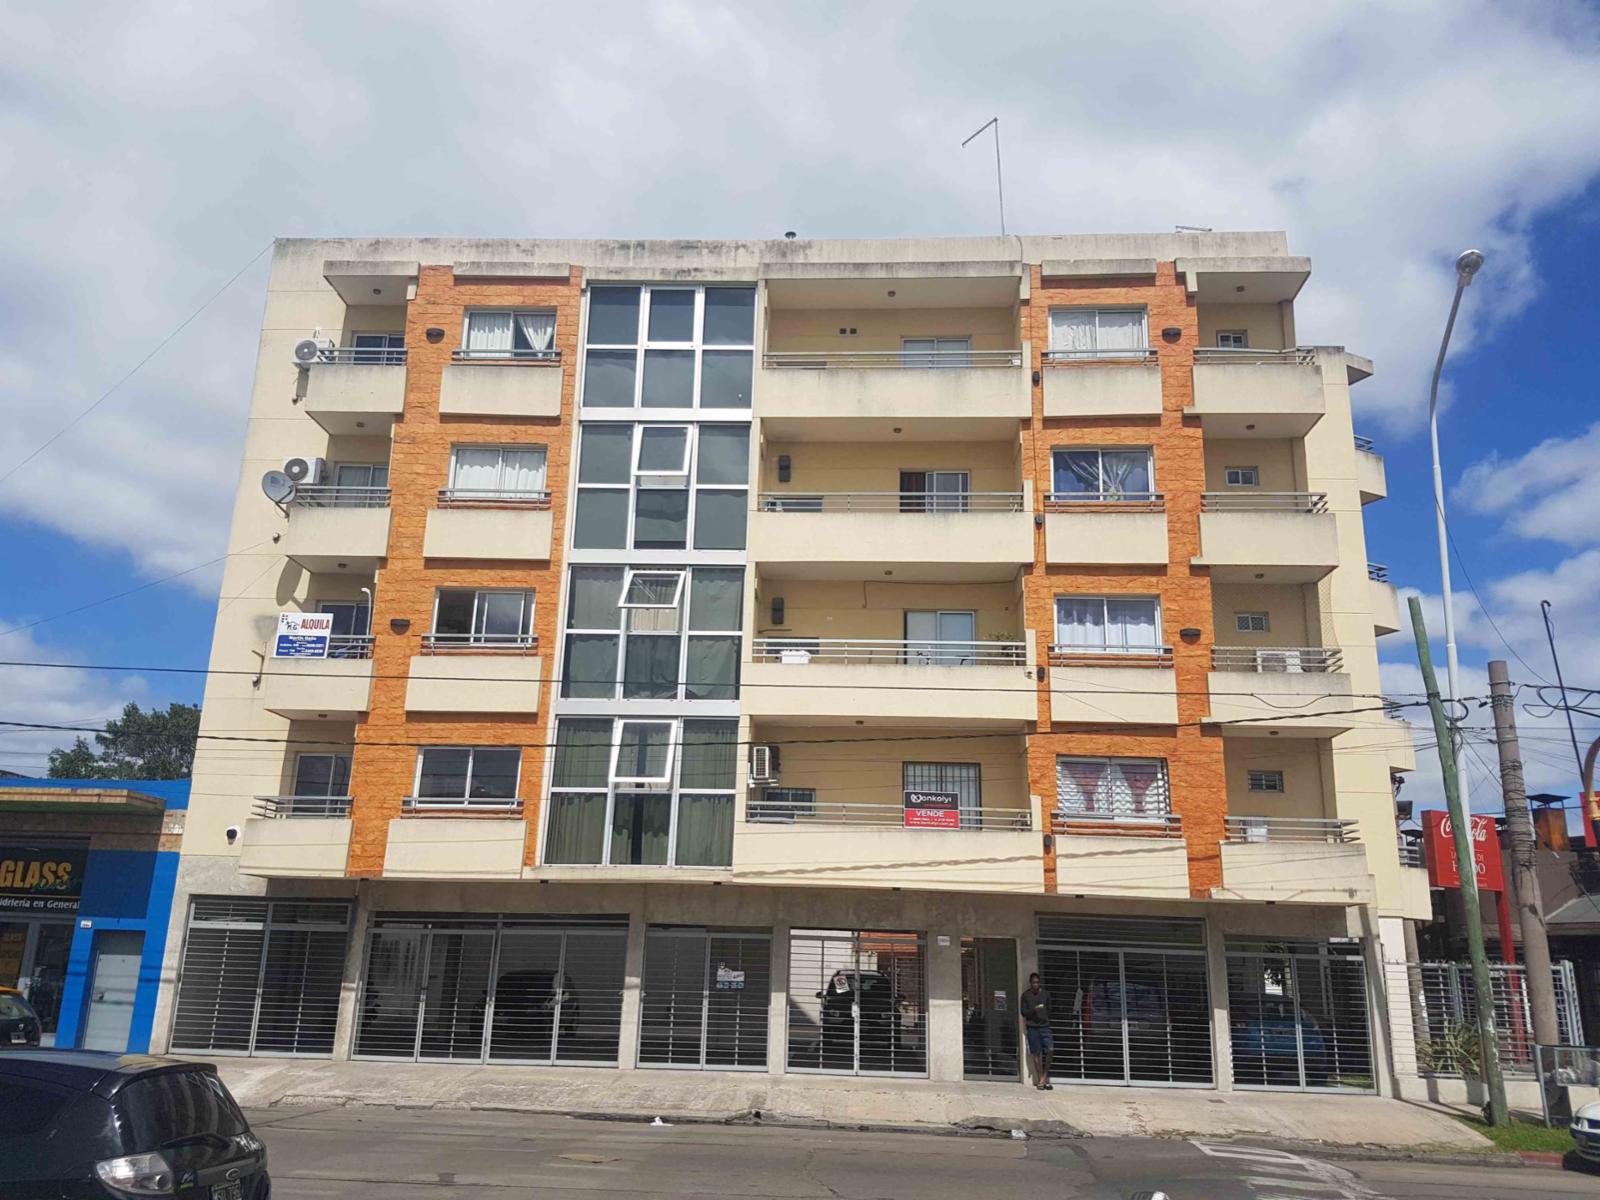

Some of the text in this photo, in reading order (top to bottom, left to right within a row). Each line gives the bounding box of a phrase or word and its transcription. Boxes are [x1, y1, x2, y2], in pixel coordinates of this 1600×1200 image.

[300, 618, 329, 630] ALQUILA
[915, 809, 945, 817] VENDE
[33, 900, 44, 908] en
[46, 900, 80, 910] General
